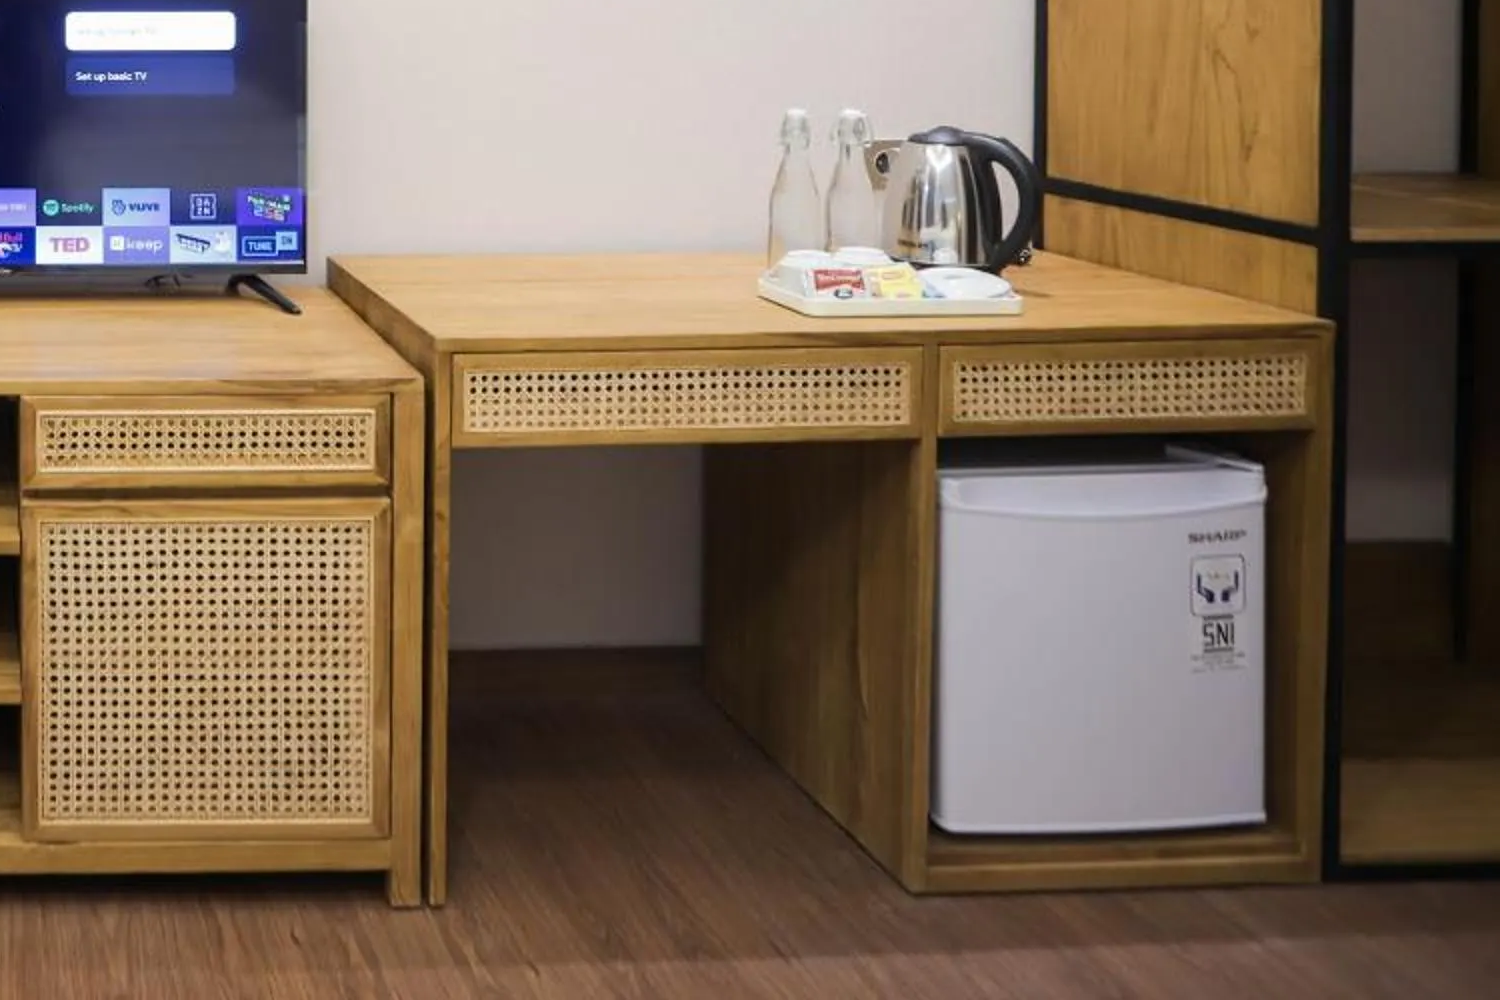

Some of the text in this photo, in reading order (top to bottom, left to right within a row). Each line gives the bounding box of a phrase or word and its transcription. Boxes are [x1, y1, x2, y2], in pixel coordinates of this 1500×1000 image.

[76, 71, 148, 83] Set up basic TV
[61, 203, 94, 215] Spotify
[50, 237, 91, 253] TED
[127, 236, 163, 254] keep
[1188, 529, 1247, 542] SHARP
[1203, 621, 1235, 647] SNI
